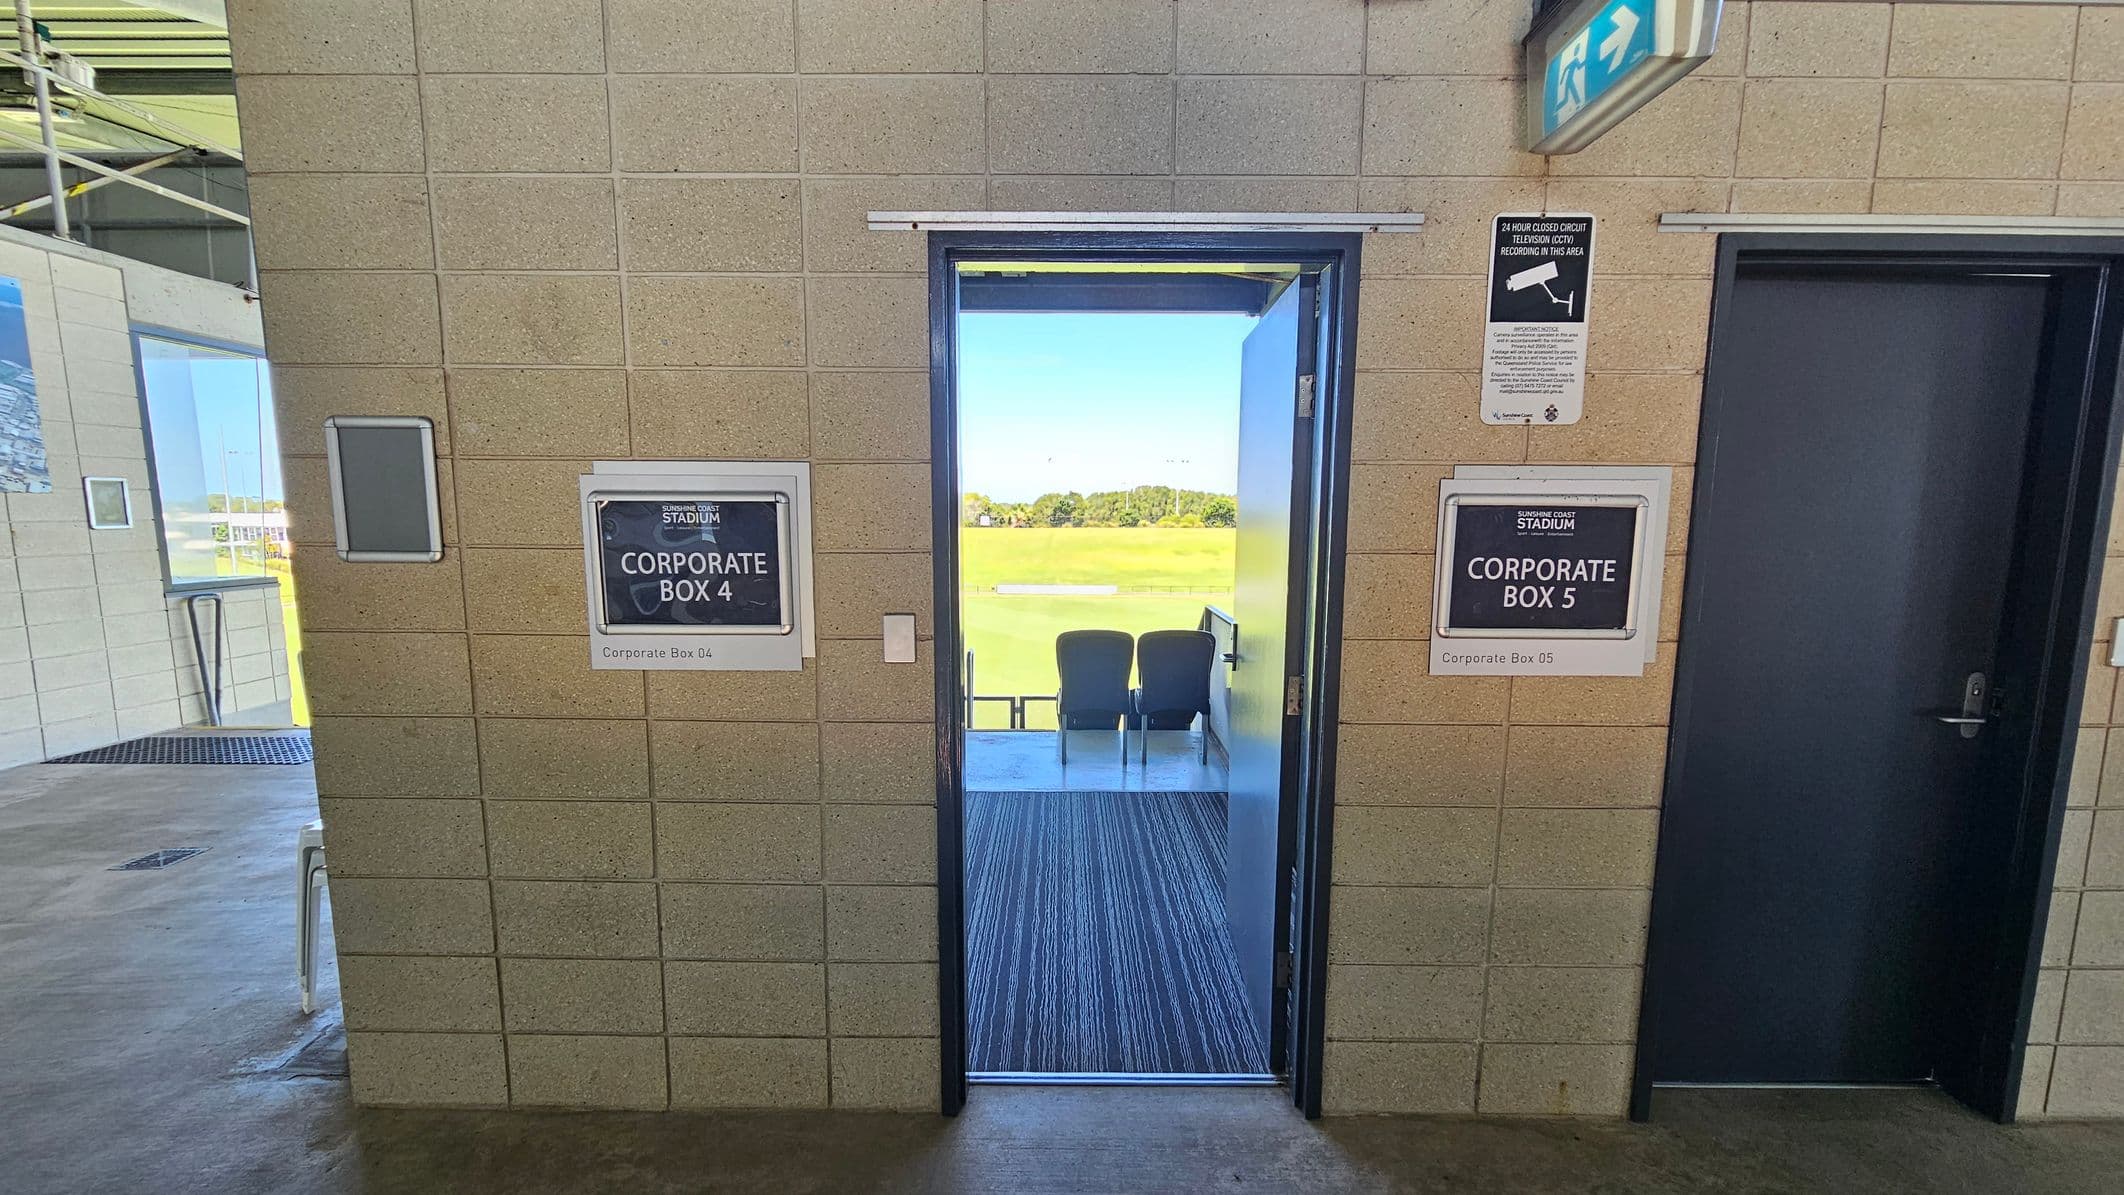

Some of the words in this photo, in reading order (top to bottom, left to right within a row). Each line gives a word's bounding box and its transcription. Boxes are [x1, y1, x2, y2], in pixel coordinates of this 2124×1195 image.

[1502, 223, 1510, 232] 24
[1512, 223, 1531, 232] HOUR
[1532, 223, 1558, 232] CLOSED
[1560, 223, 1586, 232] CIRCUIT
[1512, 235, 1550, 244] TELEVISION
[1552, 235, 1574, 244] (CCTV)
[1501, 247, 1539, 256] RECORDING
[1541, 247, 1548, 256] IN
[1550, 247, 1565, 256] THIS
[1566, 247, 1584, 256] AREA
[662, 512, 720, 523] STADIUM
[1517, 518, 1575, 529] STADIUM
[621, 552, 768, 575] CORPORATE
[1468, 557, 1617, 582] CORPORATE
[660, 580, 710, 602] BOX
[718, 580, 732, 602] 4
[1503, 585, 1555, 608] BOX
[1562, 587, 1576, 608] 5
[603, 647, 666, 660] Corporate
[671, 648, 694, 658] Box
[698, 648, 712, 658] 04
[1442, 652, 1506, 665] Corporate
[1511, 653, 1534, 663] Box
[1539, 653, 1553, 663] 05
